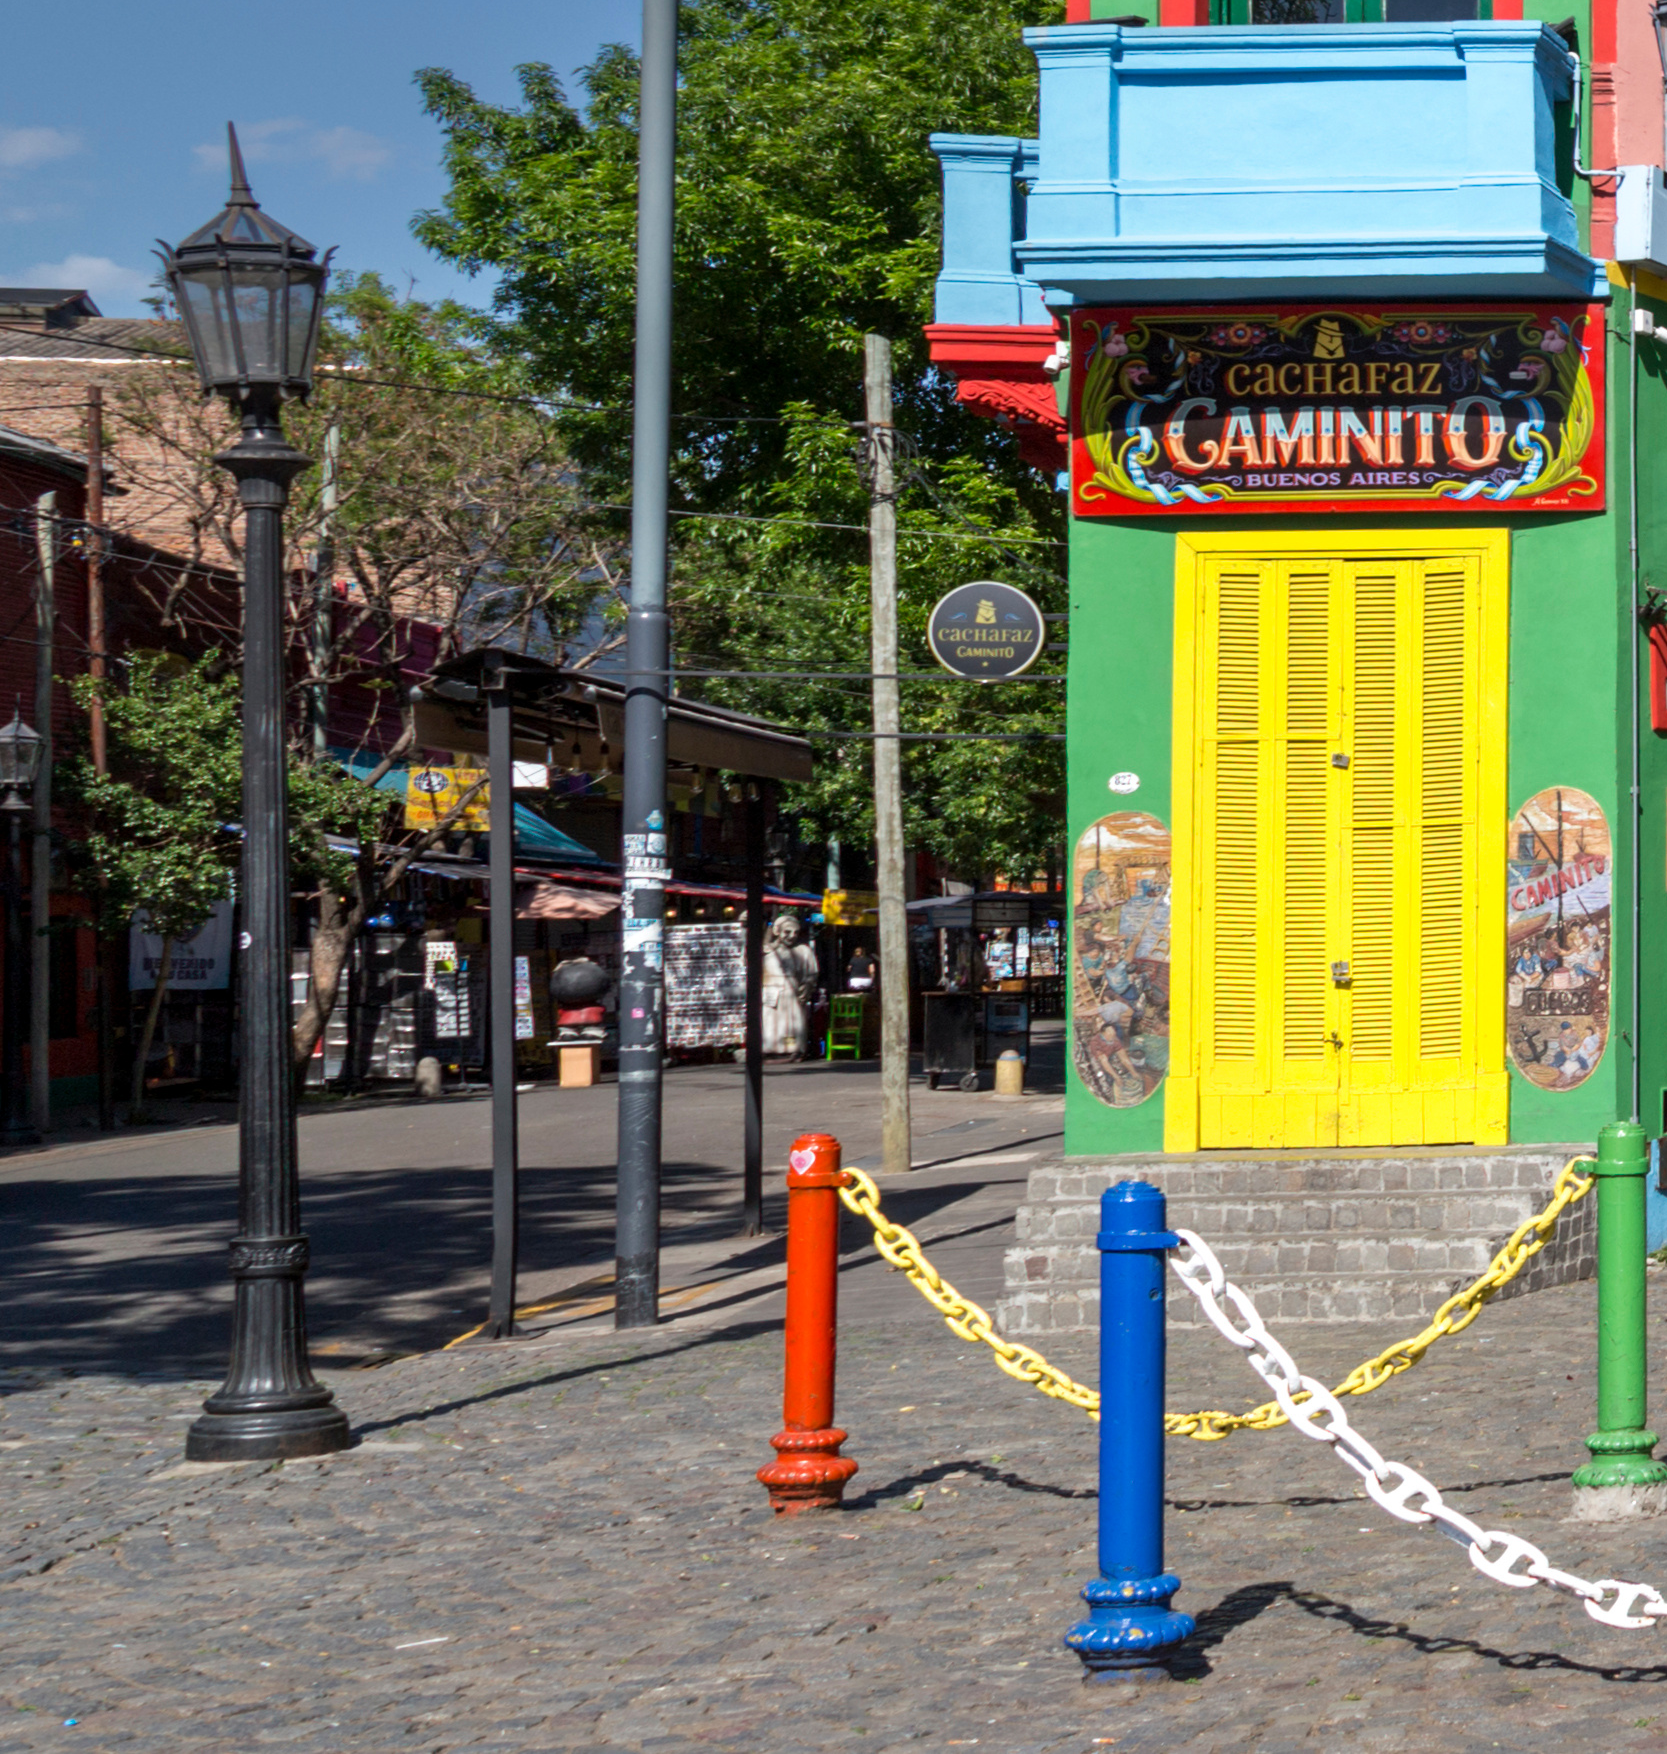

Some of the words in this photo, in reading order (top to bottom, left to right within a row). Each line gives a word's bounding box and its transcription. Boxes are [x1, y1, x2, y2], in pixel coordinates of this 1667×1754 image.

[1162, 396, 1507, 474] CAMINITO
[1246, 473, 1341, 488] BUENOS
[1350, 472, 1420, 487] AIRES
[957, 646, 1014, 658] CAMINITO
[1114, 774, 1132, 786] 827
[1511, 854, 1605, 911] CAMINITO
